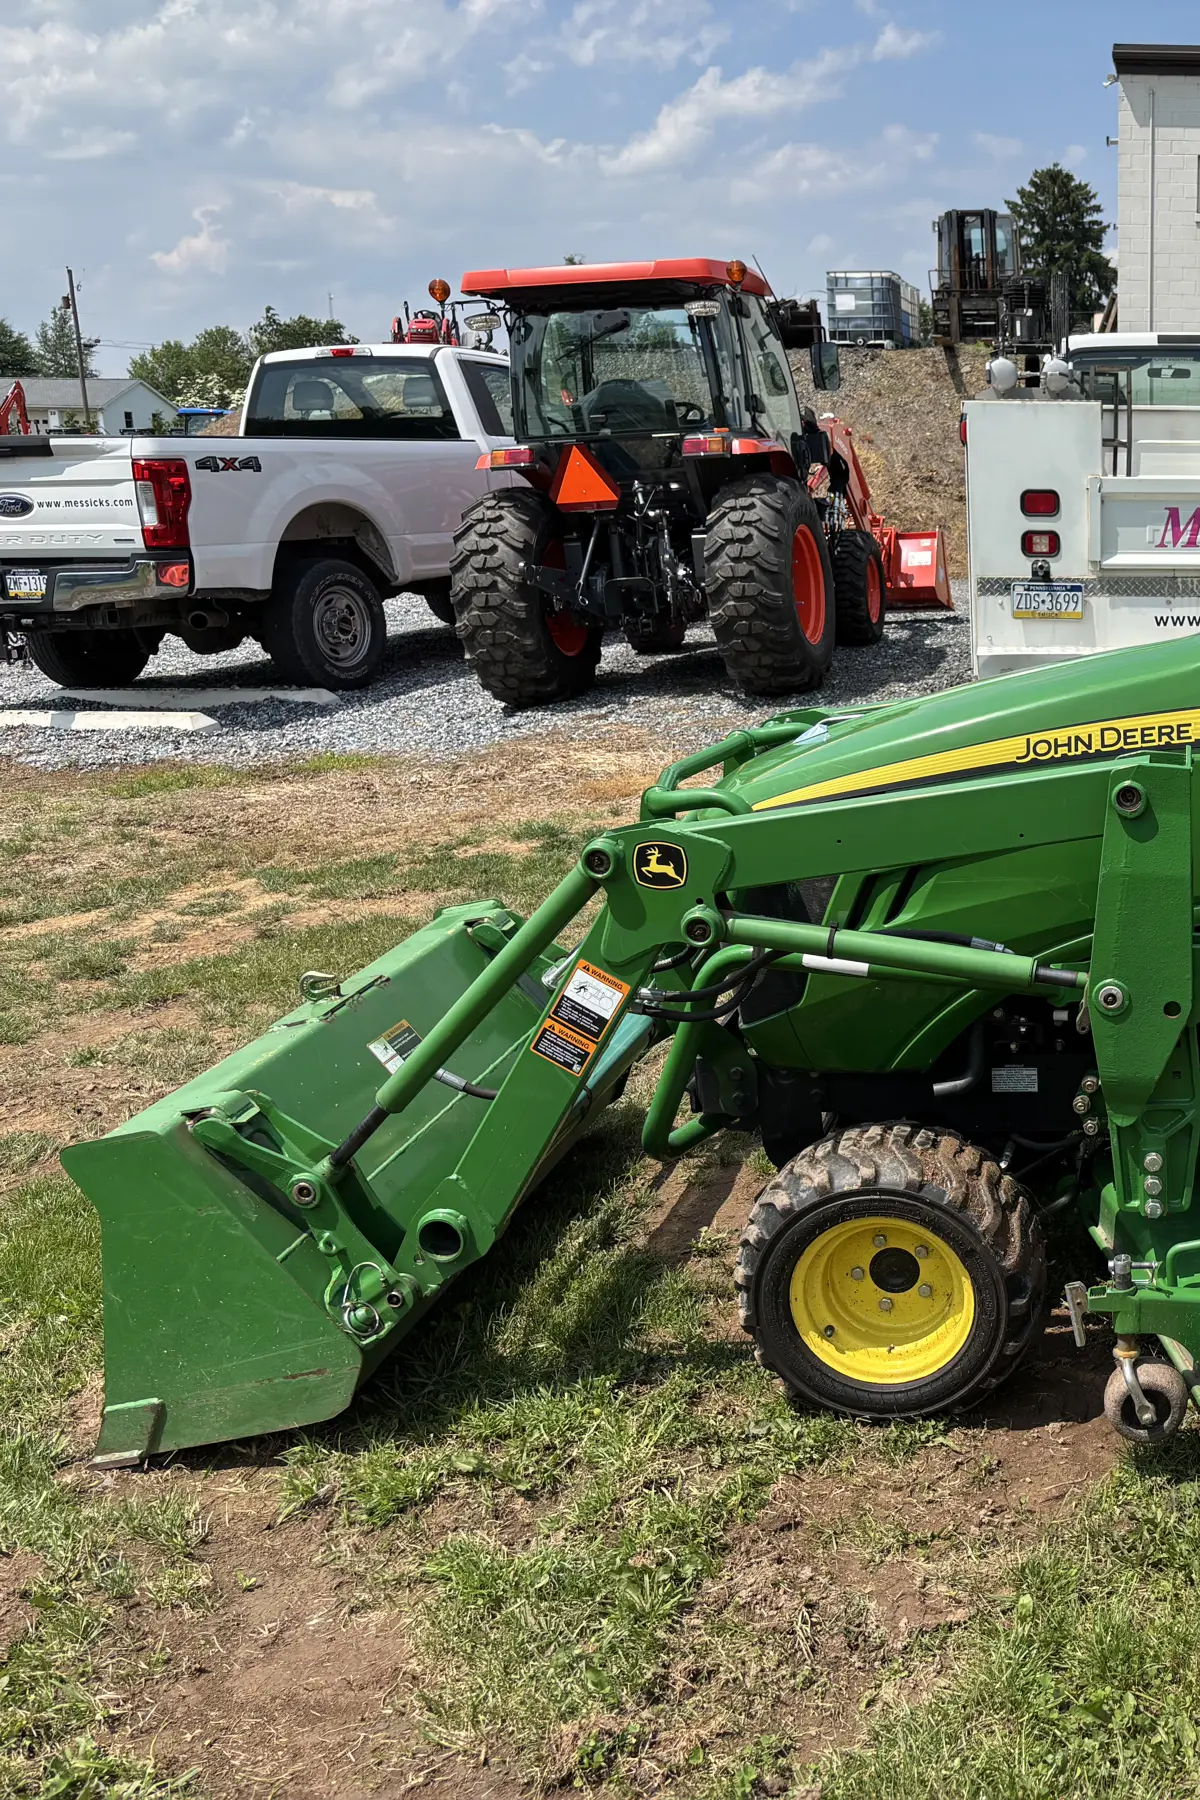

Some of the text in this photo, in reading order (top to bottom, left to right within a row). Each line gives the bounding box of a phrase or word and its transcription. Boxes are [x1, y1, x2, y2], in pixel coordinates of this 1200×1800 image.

[37, 498, 133, 508] www.messicks.com
[1015, 722, 1192, 761] JOHN DEERE
[591, 968, 624, 991] WARNING
[558, 1028, 591, 1051] WARNING
